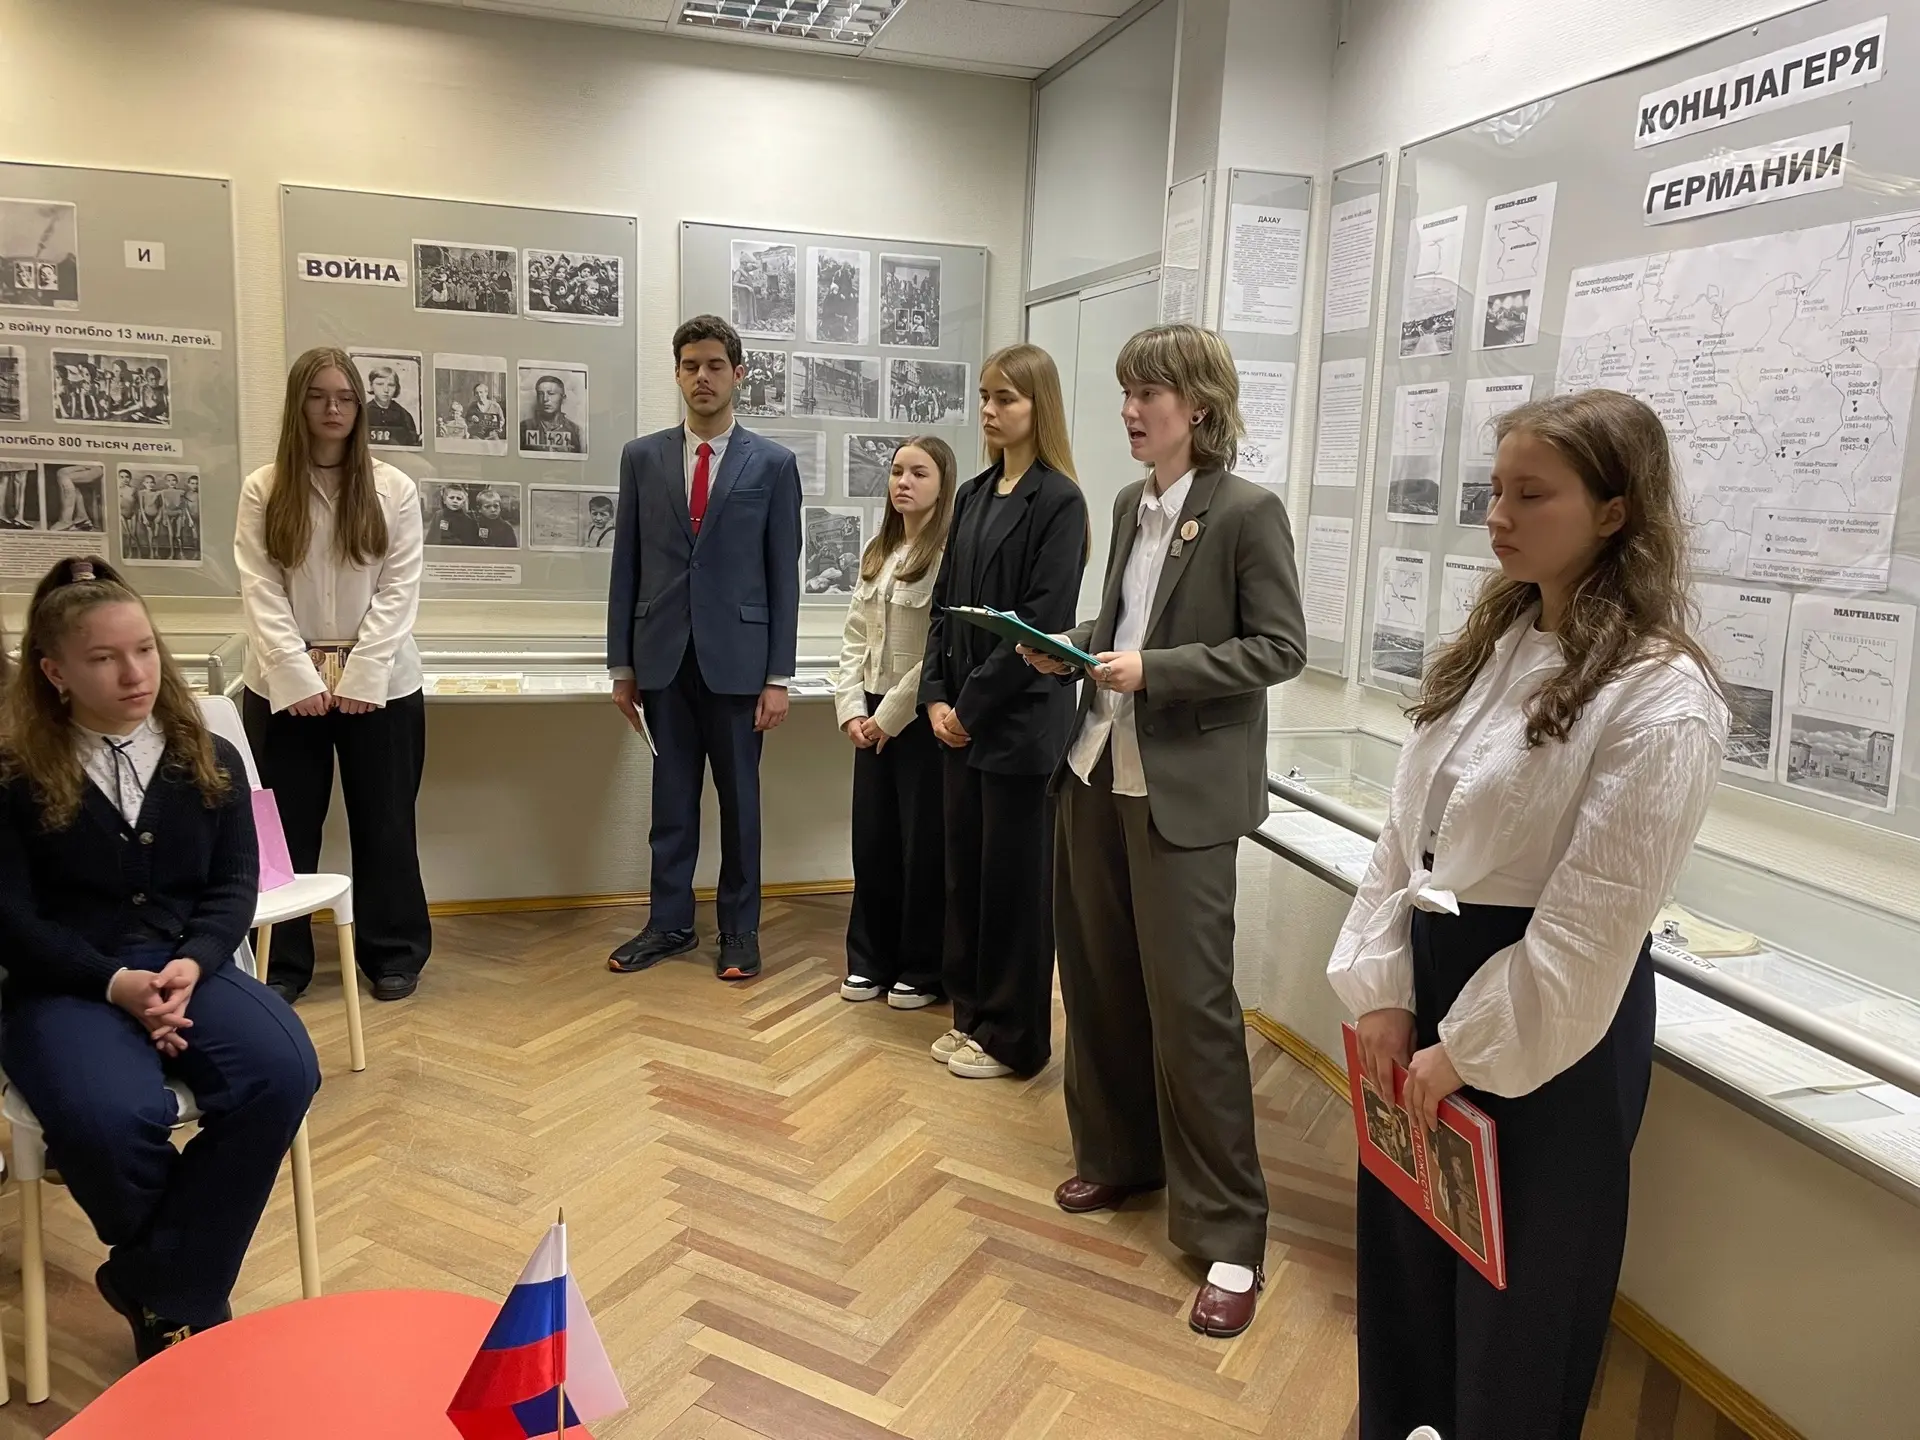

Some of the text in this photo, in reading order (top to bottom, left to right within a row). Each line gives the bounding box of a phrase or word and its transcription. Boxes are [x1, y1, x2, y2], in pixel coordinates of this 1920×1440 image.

[1638, 34, 1880, 137] КОНЦЛАГЕРЯ
[1646, 142, 1844, 214] ГЕРМАНИИ
[1257, 215, 1281, 224] ДАХАУ
[137, 249, 152, 263] И
[306, 258, 401, 282] ВОЙНА
[9, 321, 51, 336] войну
[55, 324, 113, 338] погибло
[117, 328, 132, 339] 13
[136, 332, 168, 342] мил.
[171, 333, 216, 346] детей.
[0, 434, 177, 453] погибло 800 тысяч детей.
[527, 431, 538, 445] M
[1739, 594, 1772, 605] DACHAU
[1833, 607, 1900, 623] MAUTHAUSEN
[1828, 664, 1865, 674] MAUTHAUSEN
